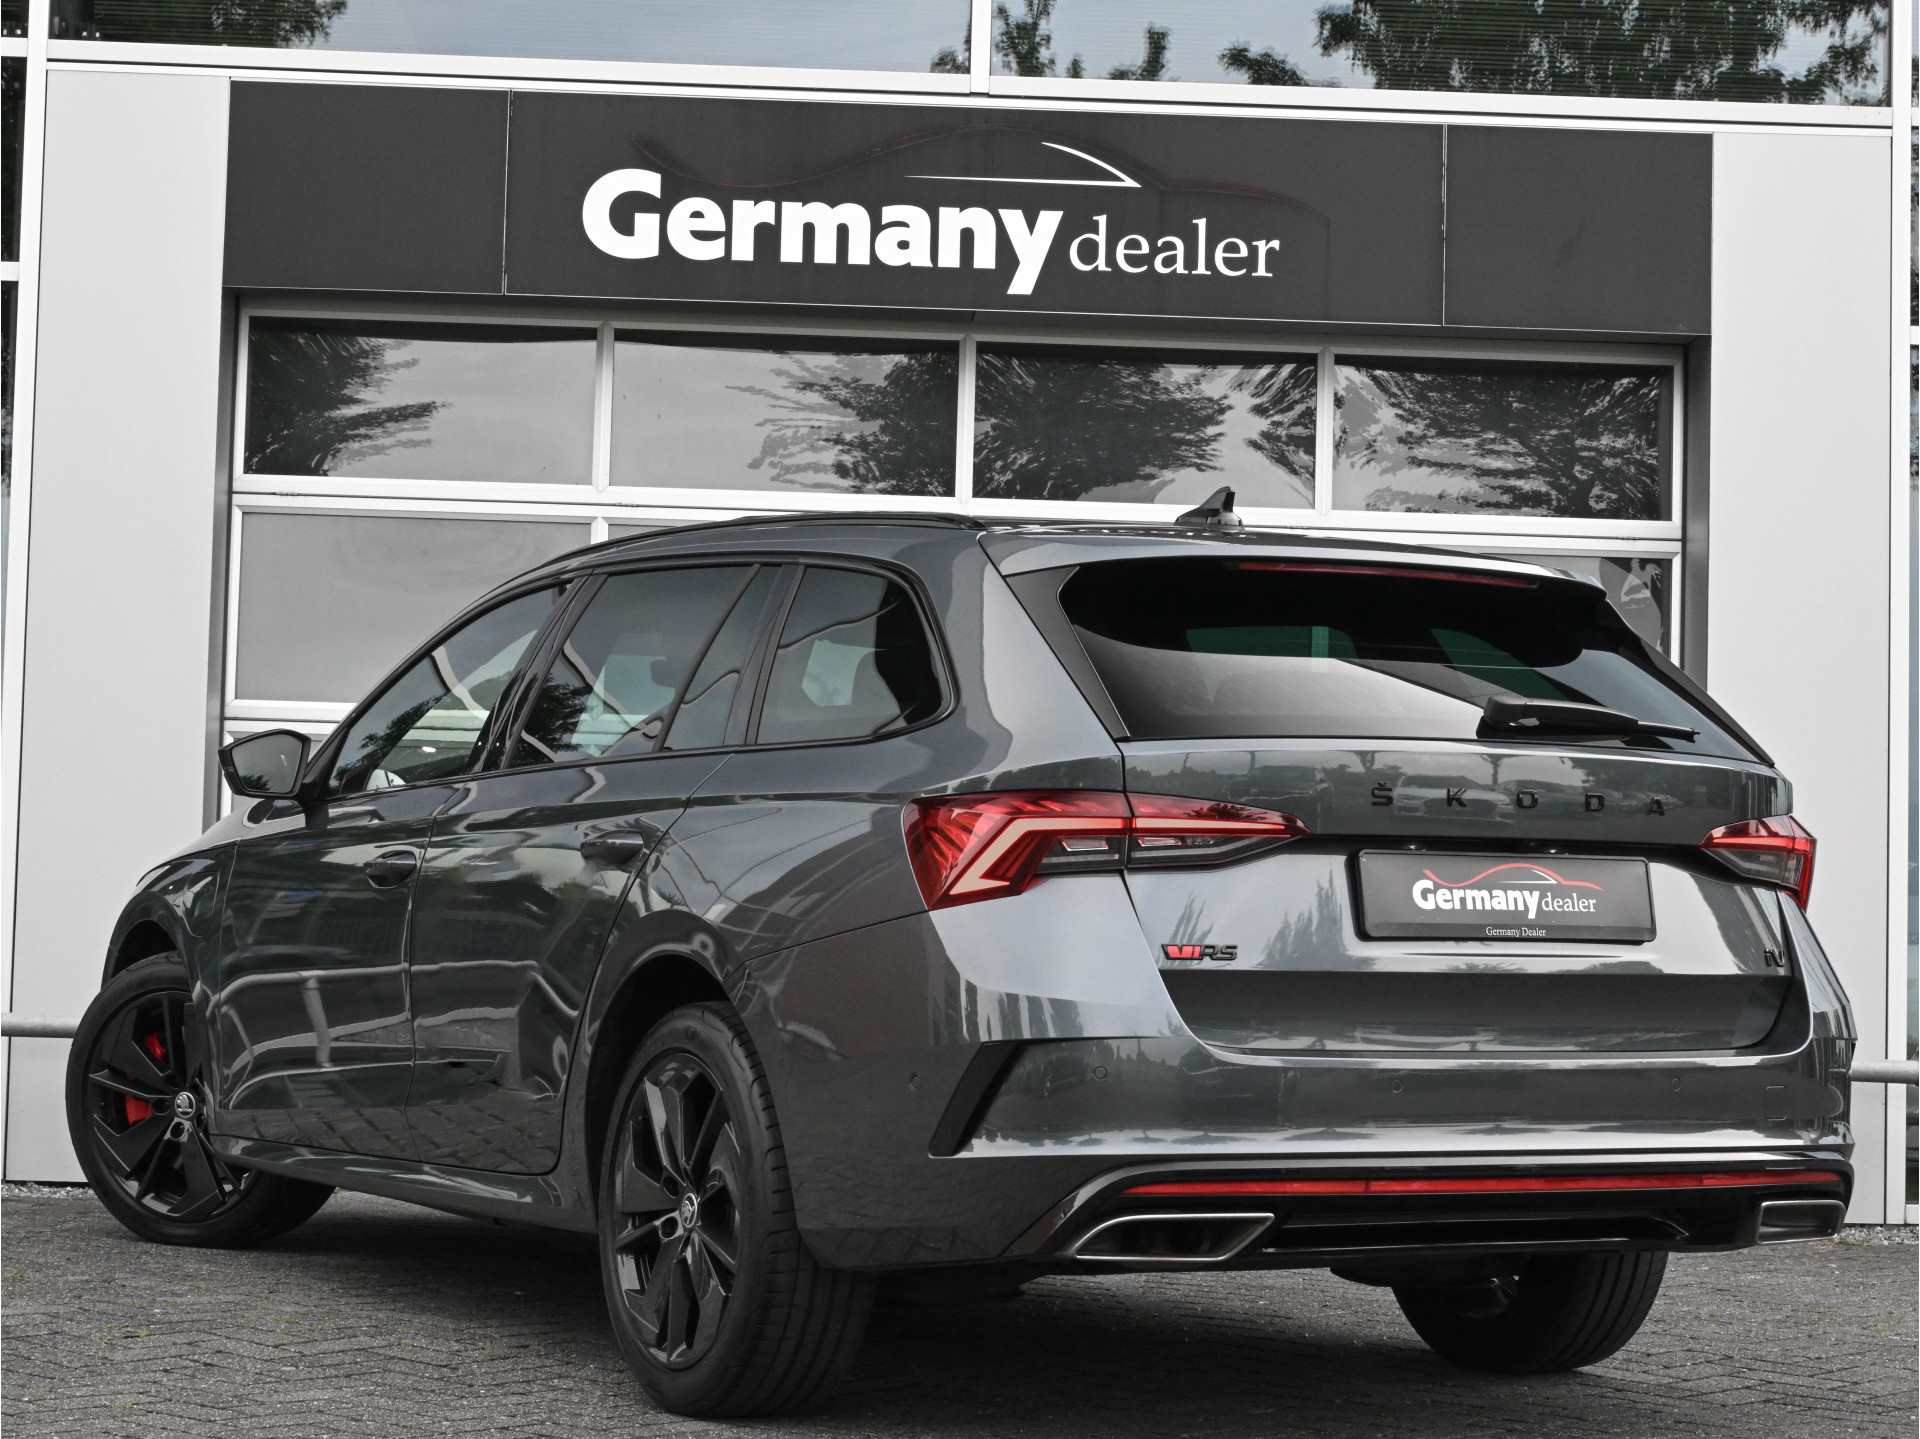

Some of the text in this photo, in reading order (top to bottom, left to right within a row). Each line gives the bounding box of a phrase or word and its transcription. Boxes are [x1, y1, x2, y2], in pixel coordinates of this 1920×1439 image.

[582, 168, 1281, 295] Germany dealer
[1371, 781, 1666, 816] ŠKODA
[1412, 879, 1597, 919] Germany dealer
[1485, 926, 1547, 938] Germany Dealer
